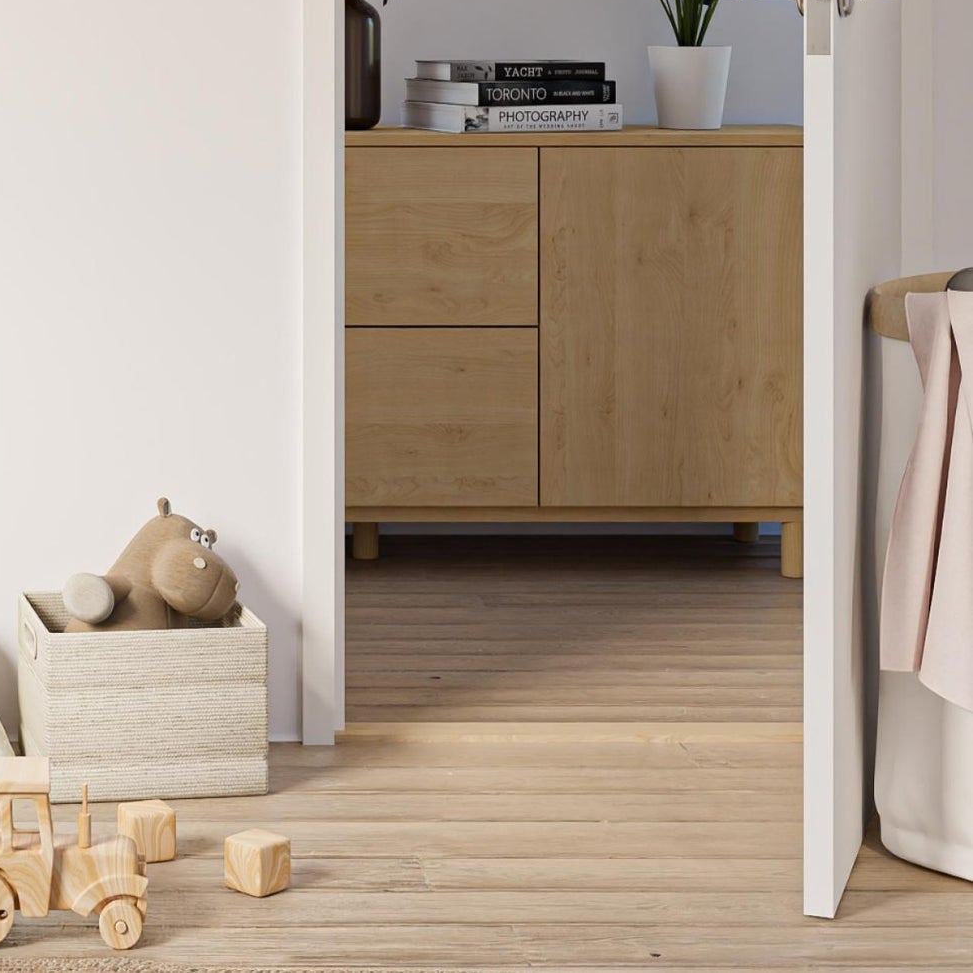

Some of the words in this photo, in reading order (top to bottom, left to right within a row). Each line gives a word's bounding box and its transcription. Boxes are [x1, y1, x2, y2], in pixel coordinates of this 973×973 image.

[504, 67, 543, 77] YACHT
[486, 87, 547, 101] TORONTO
[499, 110, 588, 123] PHOTOGRAPHY
